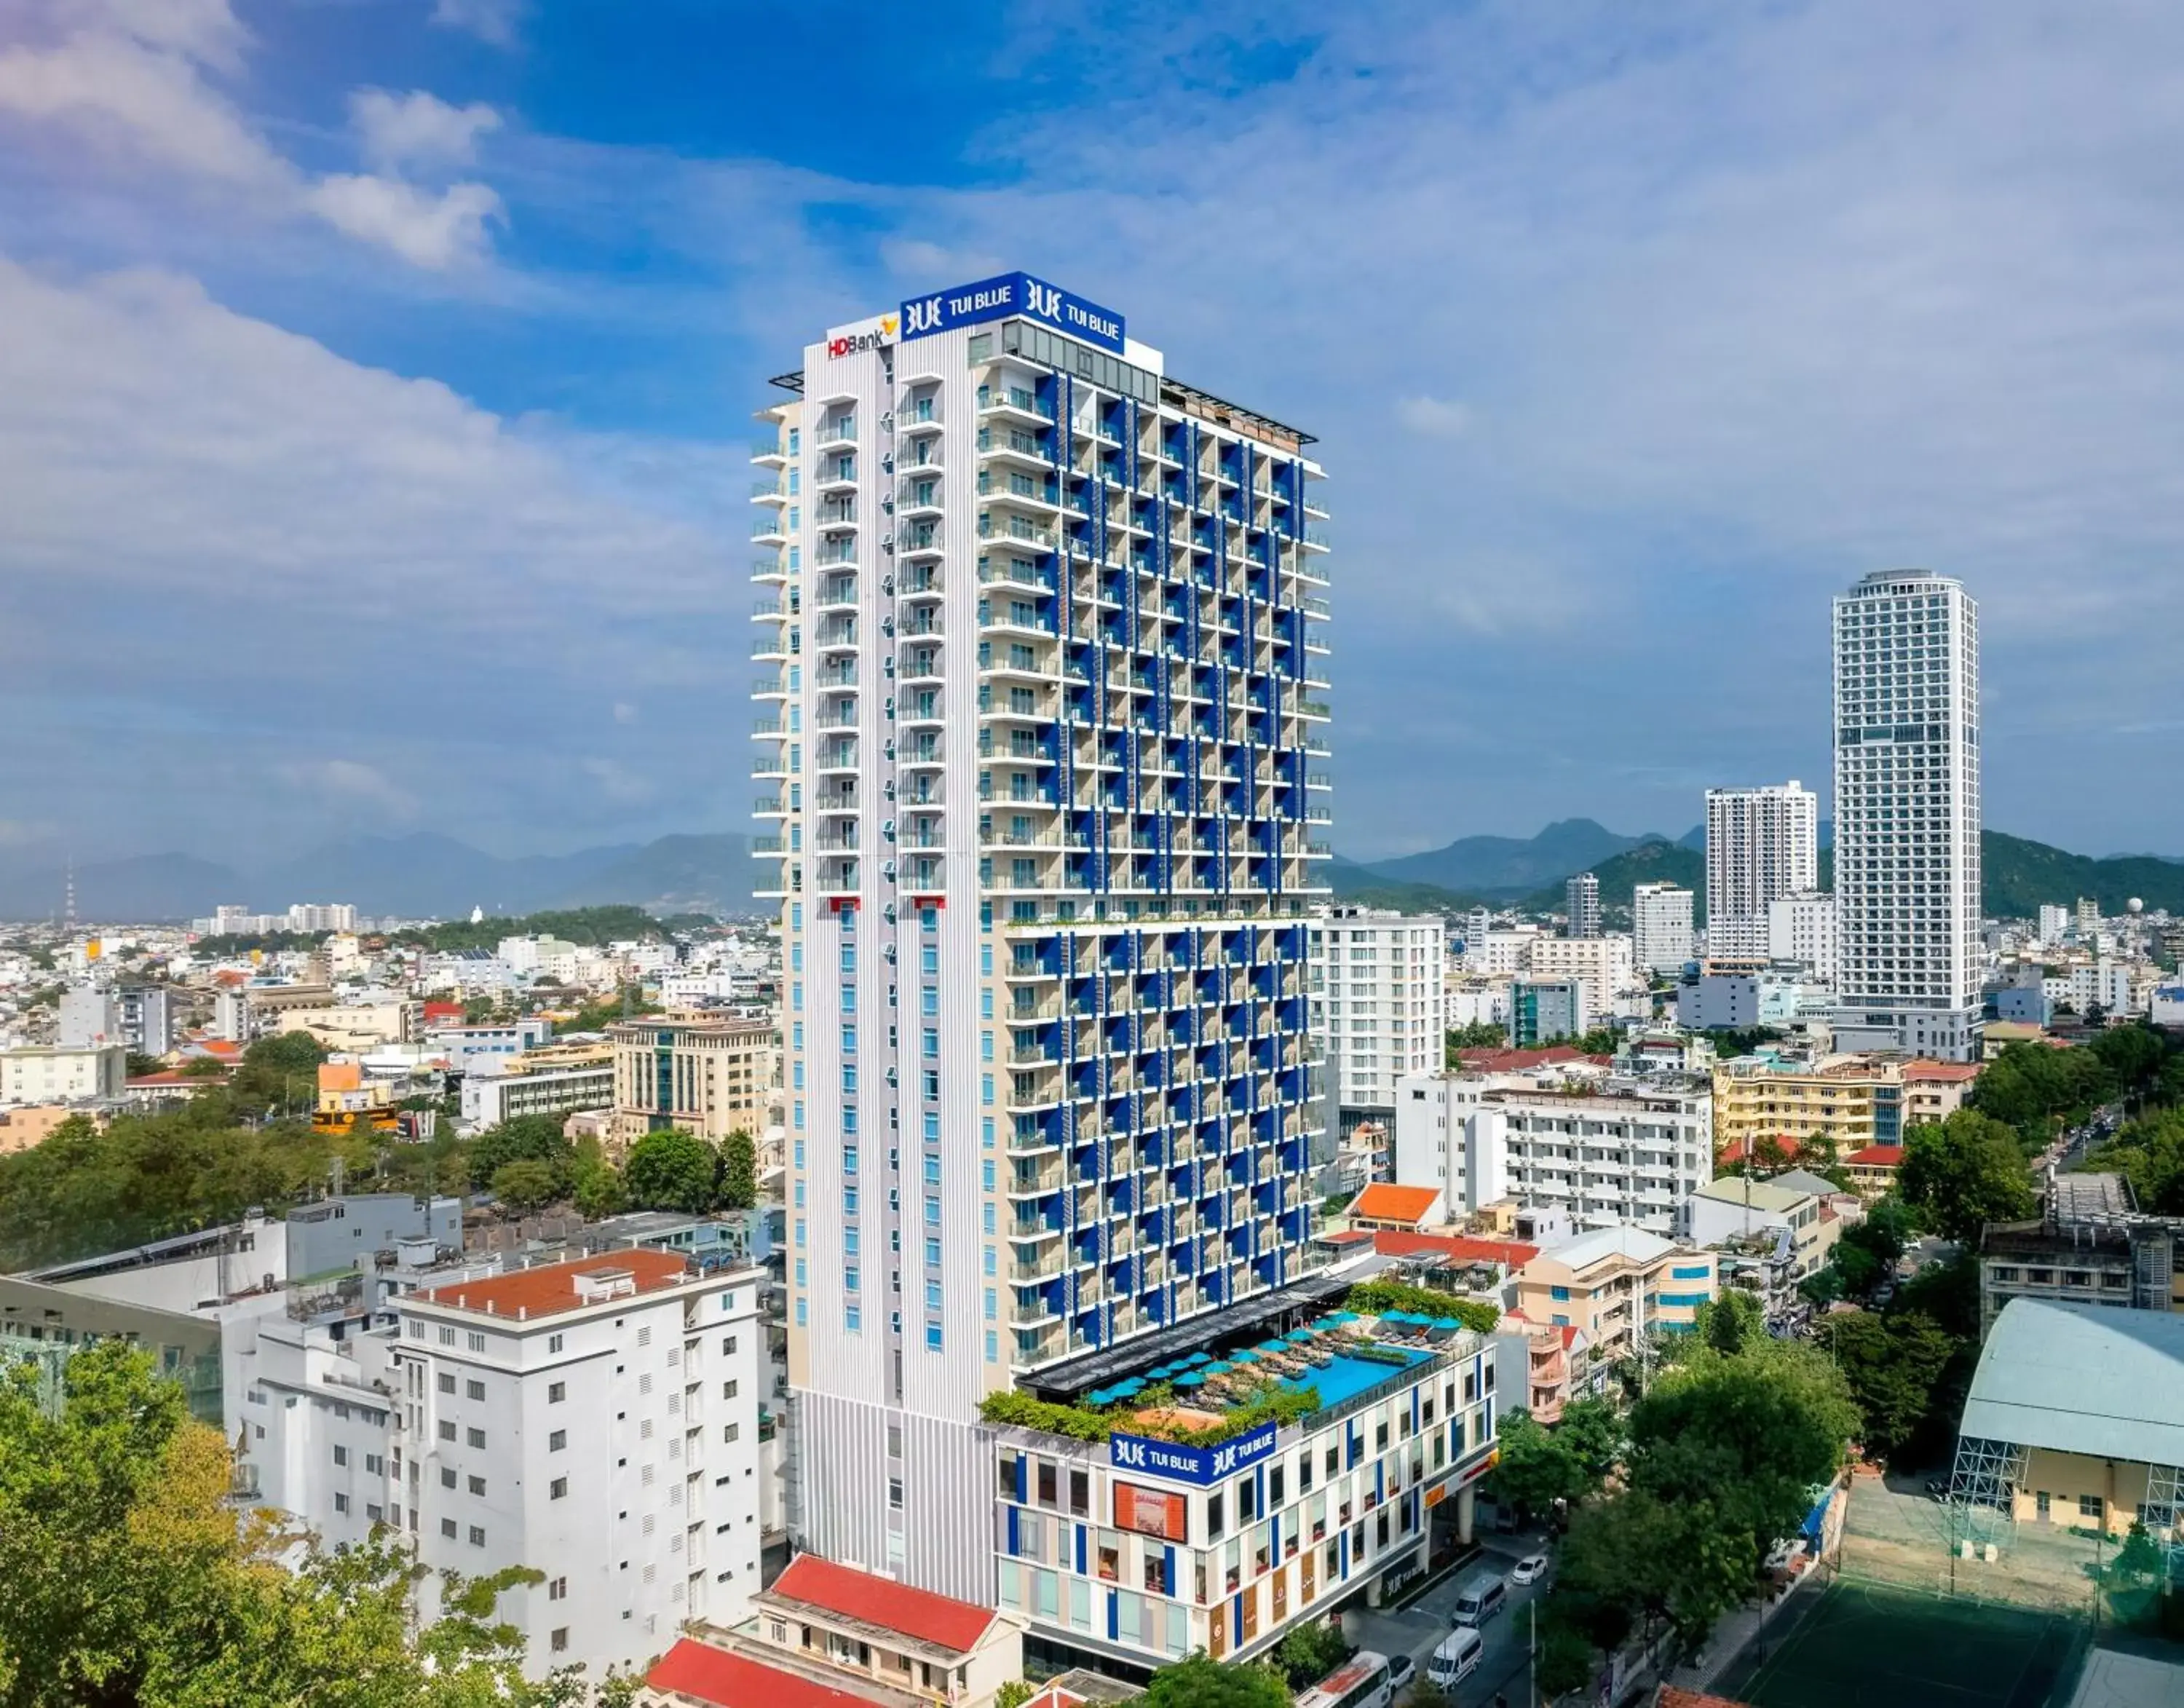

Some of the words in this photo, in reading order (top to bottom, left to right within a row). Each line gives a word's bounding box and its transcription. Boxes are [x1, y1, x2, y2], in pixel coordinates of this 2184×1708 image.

[949, 295, 972, 316] TUI
[975, 285, 1011, 309] BLUE
[1066, 304, 1087, 326] TUI
[1088, 314, 1119, 341] BLUE
[828, 329, 883, 357] HDBank
[1239, 1444, 1252, 1458] TUI
[1253, 1432, 1273, 1451] BLUE
[1150, 1451, 1168, 1466] TUI
[1169, 1455, 1199, 1473] BLUE
